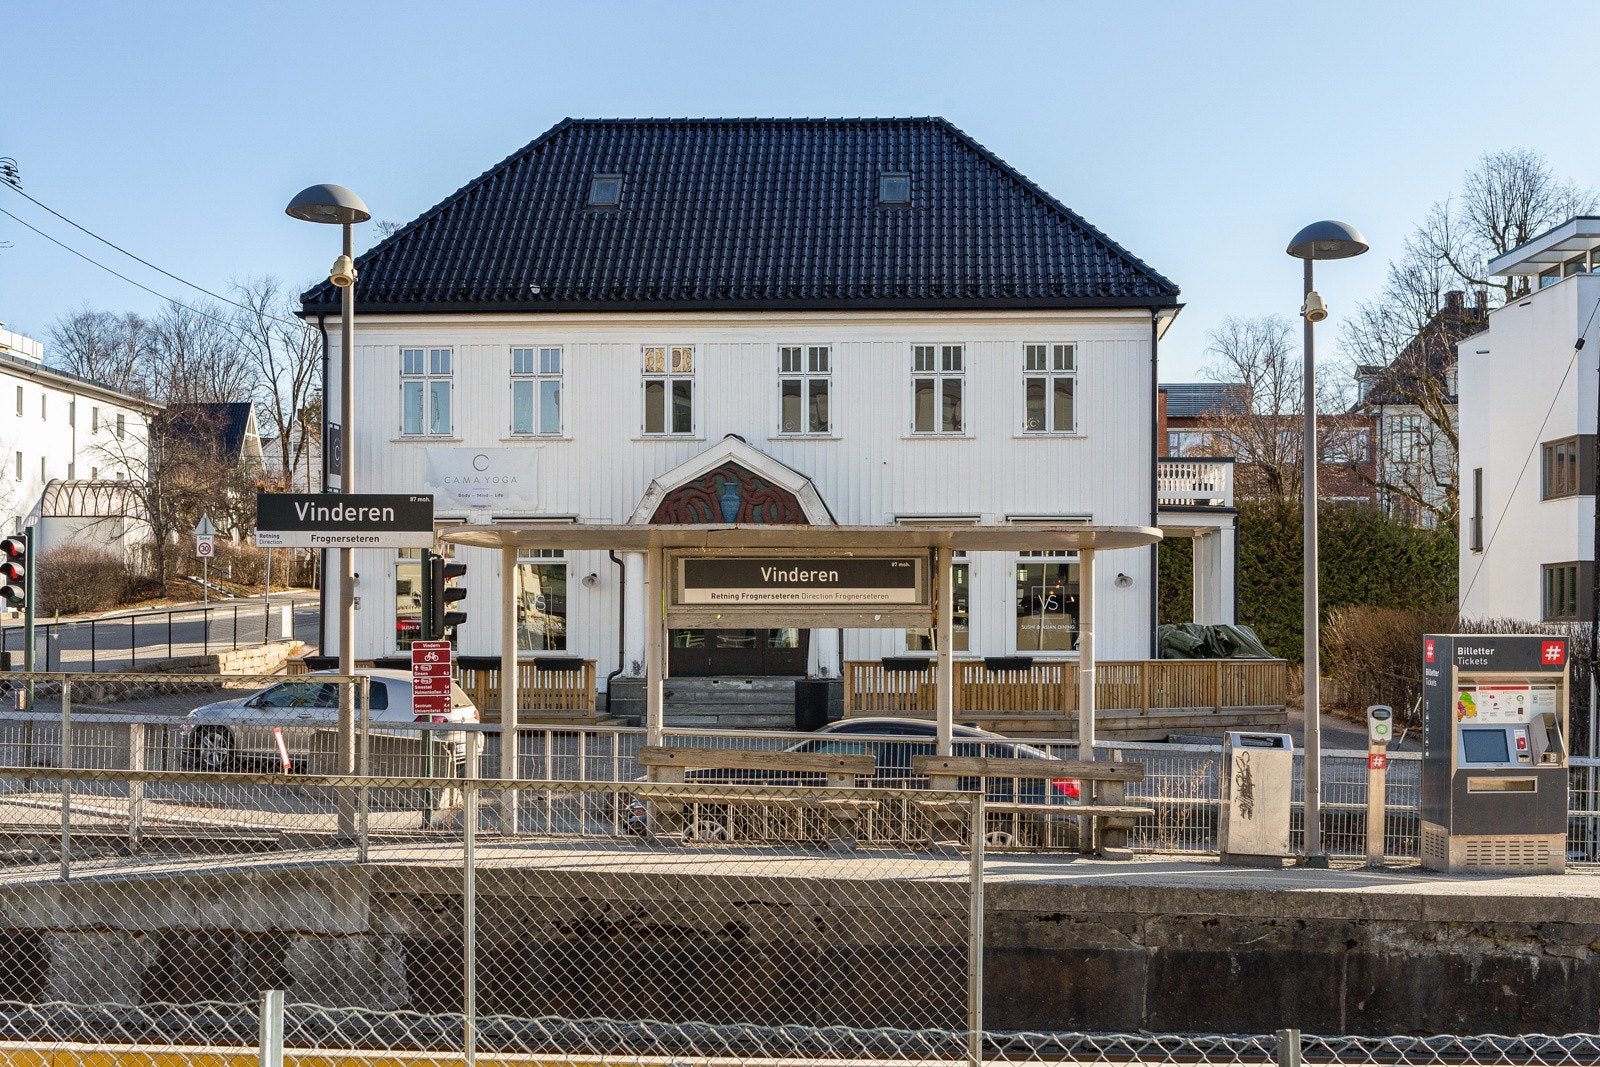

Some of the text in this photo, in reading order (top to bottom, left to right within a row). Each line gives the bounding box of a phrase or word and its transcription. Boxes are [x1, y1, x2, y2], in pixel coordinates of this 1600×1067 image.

[294, 502, 395, 522] Vinderen
[311, 535, 380, 544] Frognerseteren
[760, 567, 839, 582] Vinderen
[1038, 594, 1059, 610] VS
